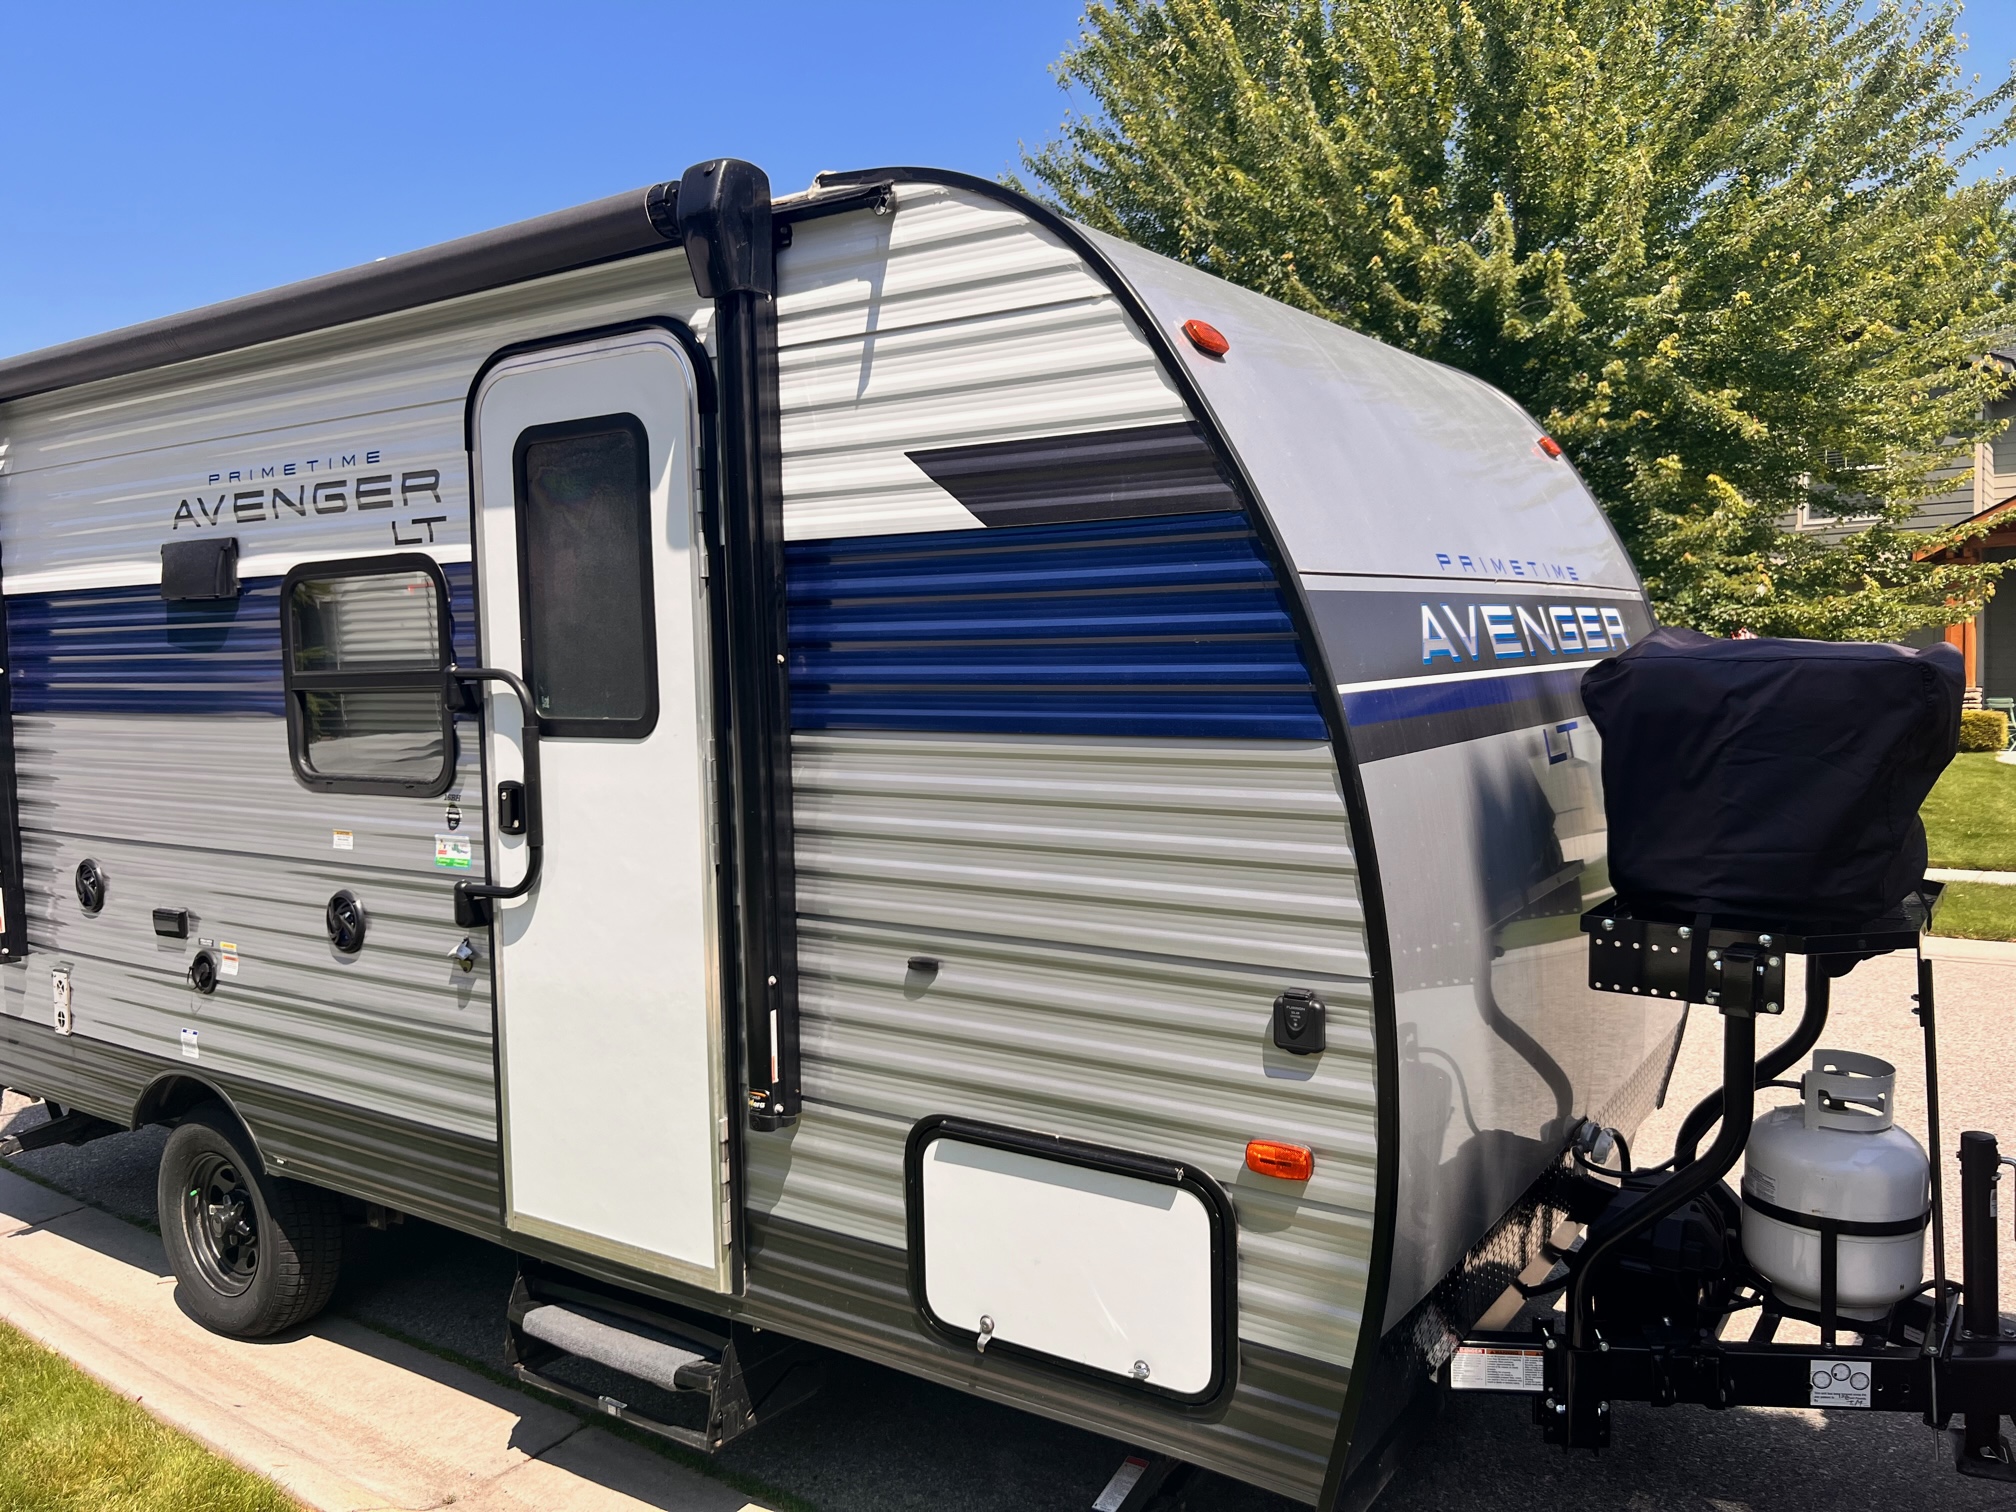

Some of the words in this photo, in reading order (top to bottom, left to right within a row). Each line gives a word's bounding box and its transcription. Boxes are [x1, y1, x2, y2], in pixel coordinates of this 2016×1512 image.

[208, 450, 381, 486] PRIMETIME
[172, 468, 442, 530] AVENGER
[391, 515, 448, 546] LT
[1435, 553, 1580, 581] PRIMETIME
[1420, 602, 1632, 665] AVENGER
[1542, 721, 1579, 766] LT
